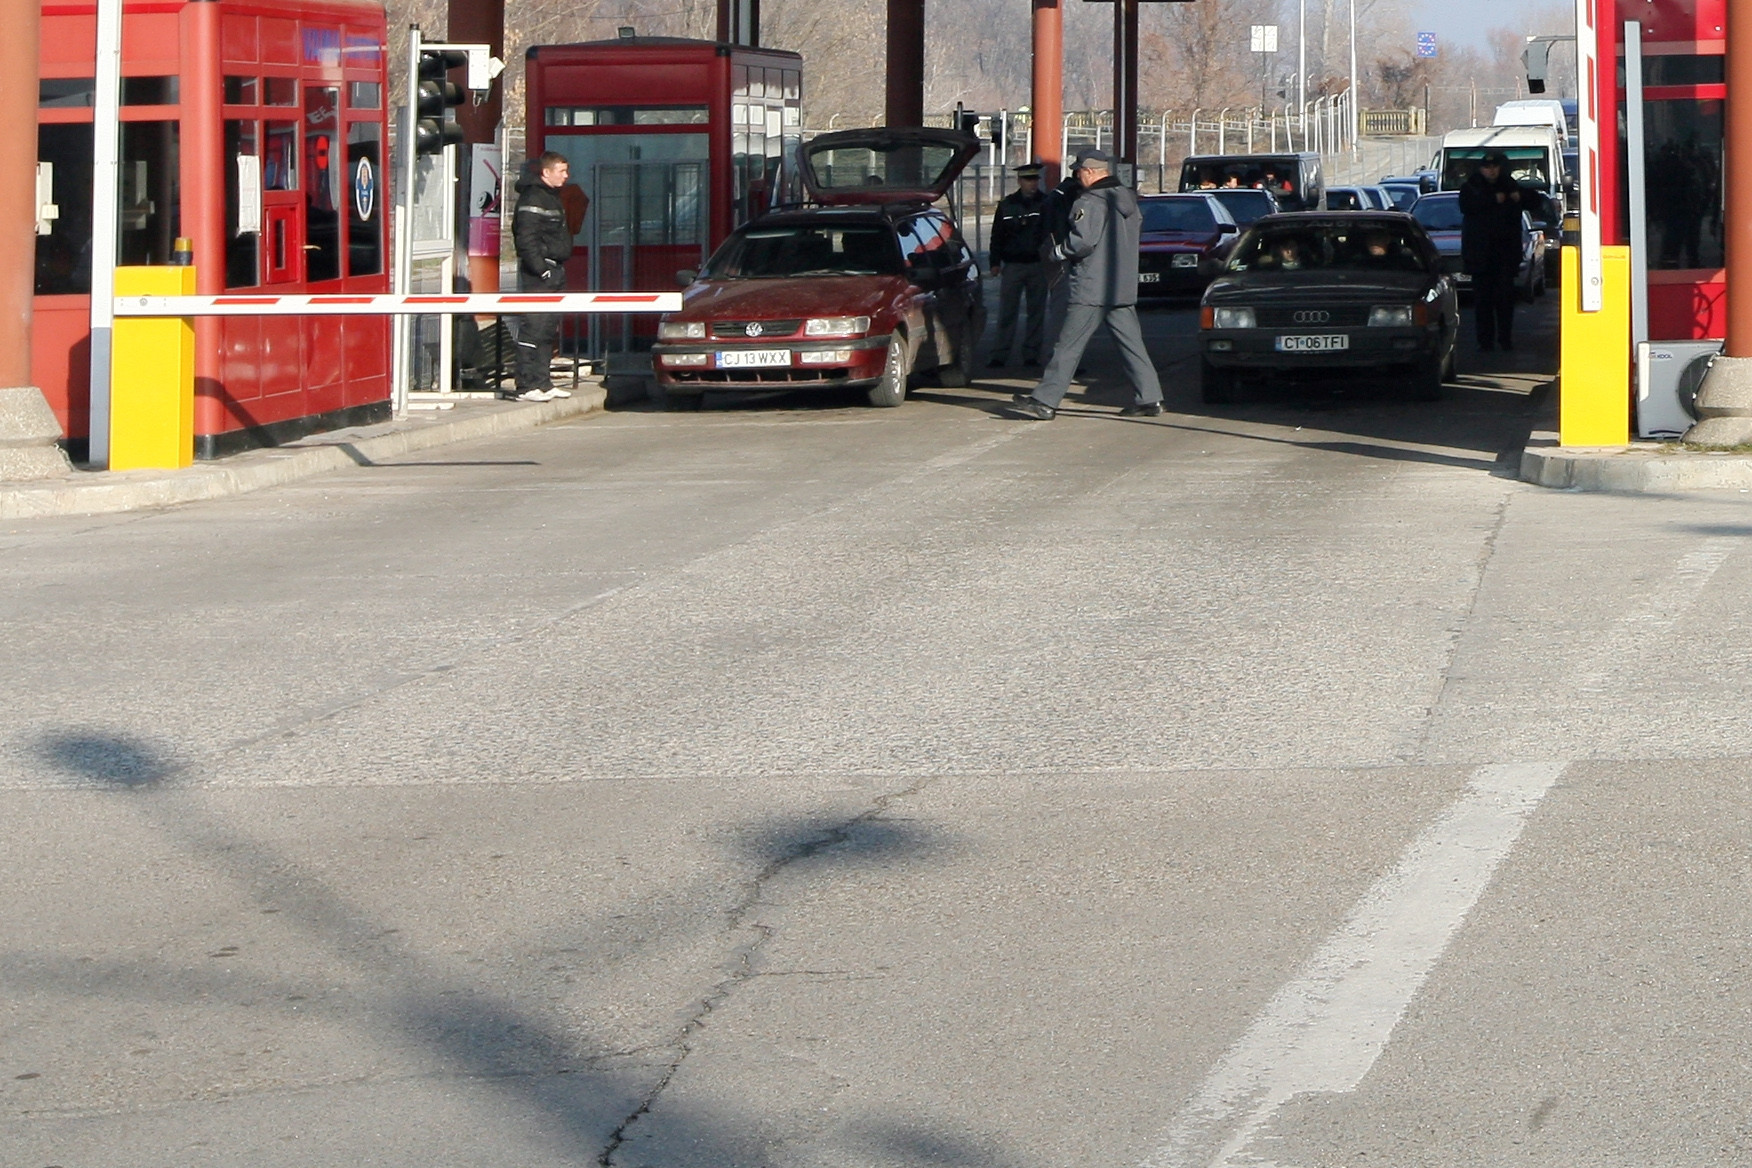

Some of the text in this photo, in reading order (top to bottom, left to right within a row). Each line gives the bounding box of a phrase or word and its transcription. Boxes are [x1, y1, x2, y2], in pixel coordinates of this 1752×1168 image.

[1284, 336, 1344, 349] CT 06 TFI
[724, 351, 787, 365] CJ 13 WXX
